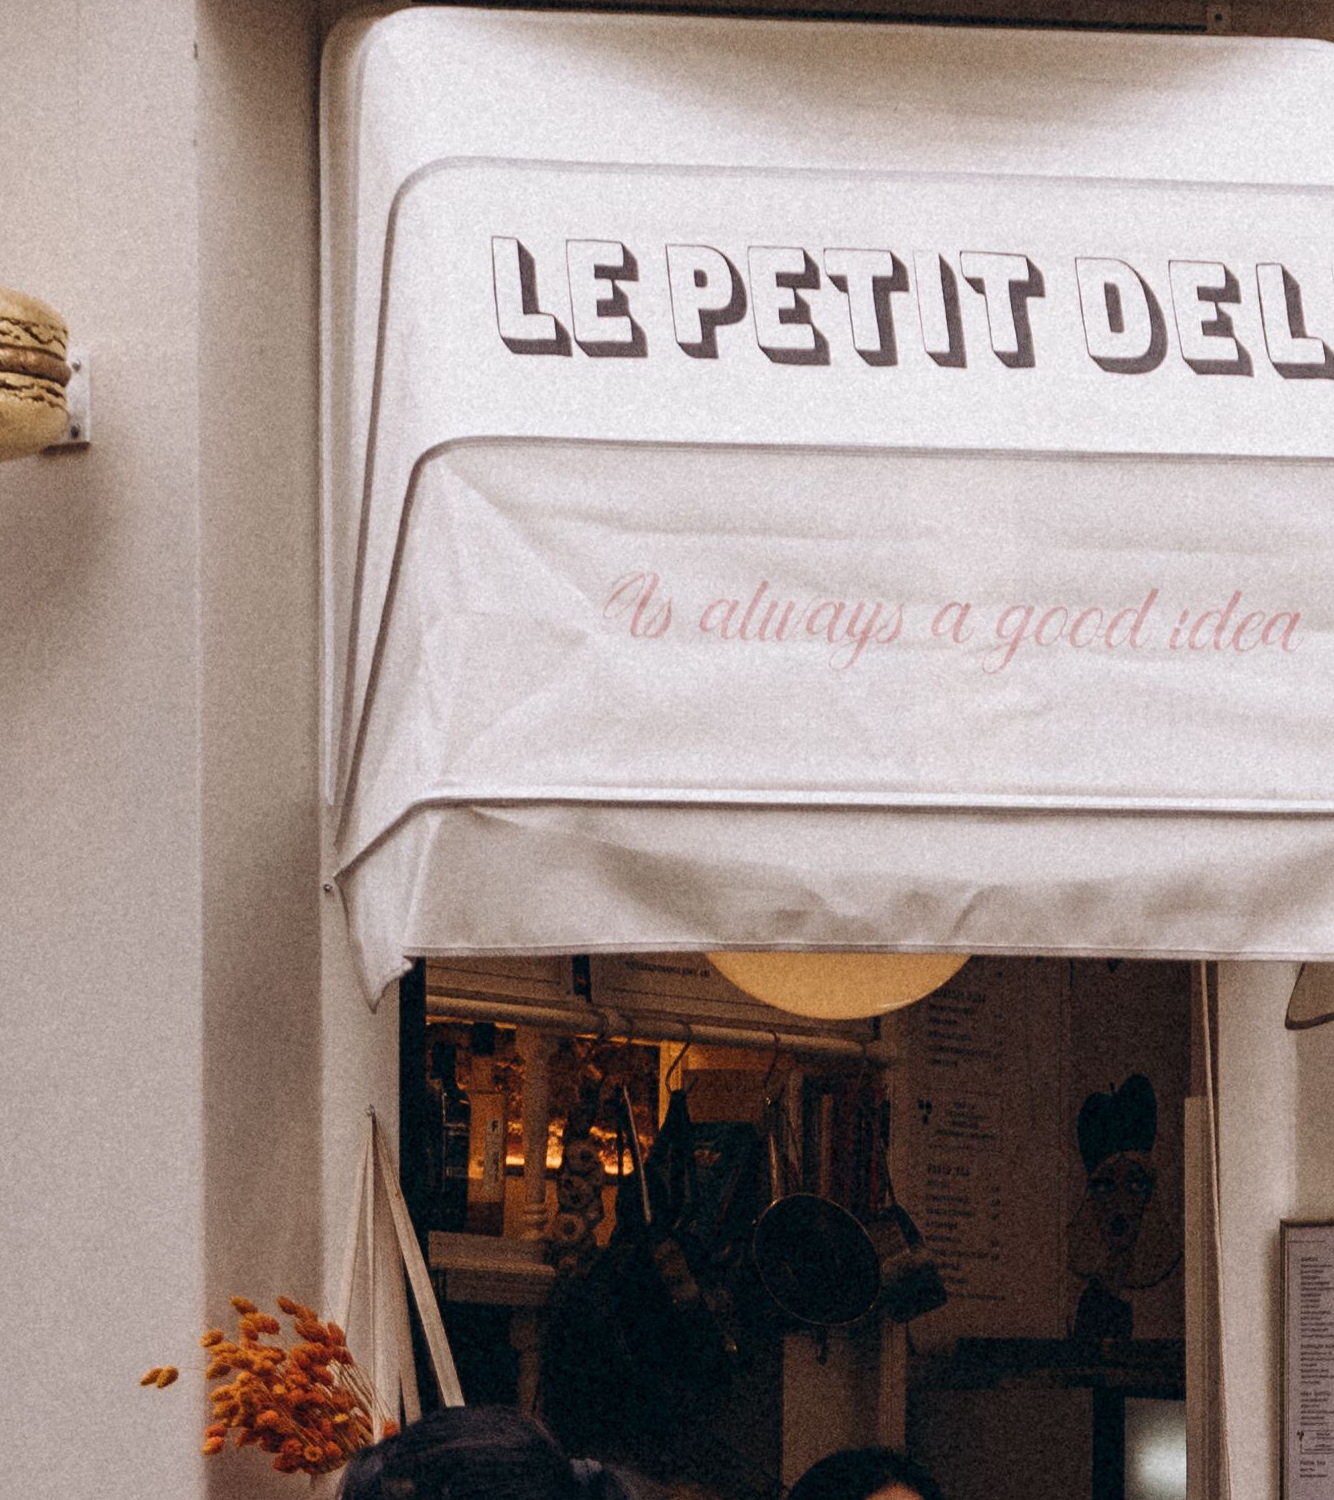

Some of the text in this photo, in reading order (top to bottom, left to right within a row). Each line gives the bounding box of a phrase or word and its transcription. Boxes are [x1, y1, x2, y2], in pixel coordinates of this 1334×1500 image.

[491, 236, 648, 358] LE
[665, 243, 1046, 369] PETIT
[603, 569, 1304, 675] Is always a good idea
